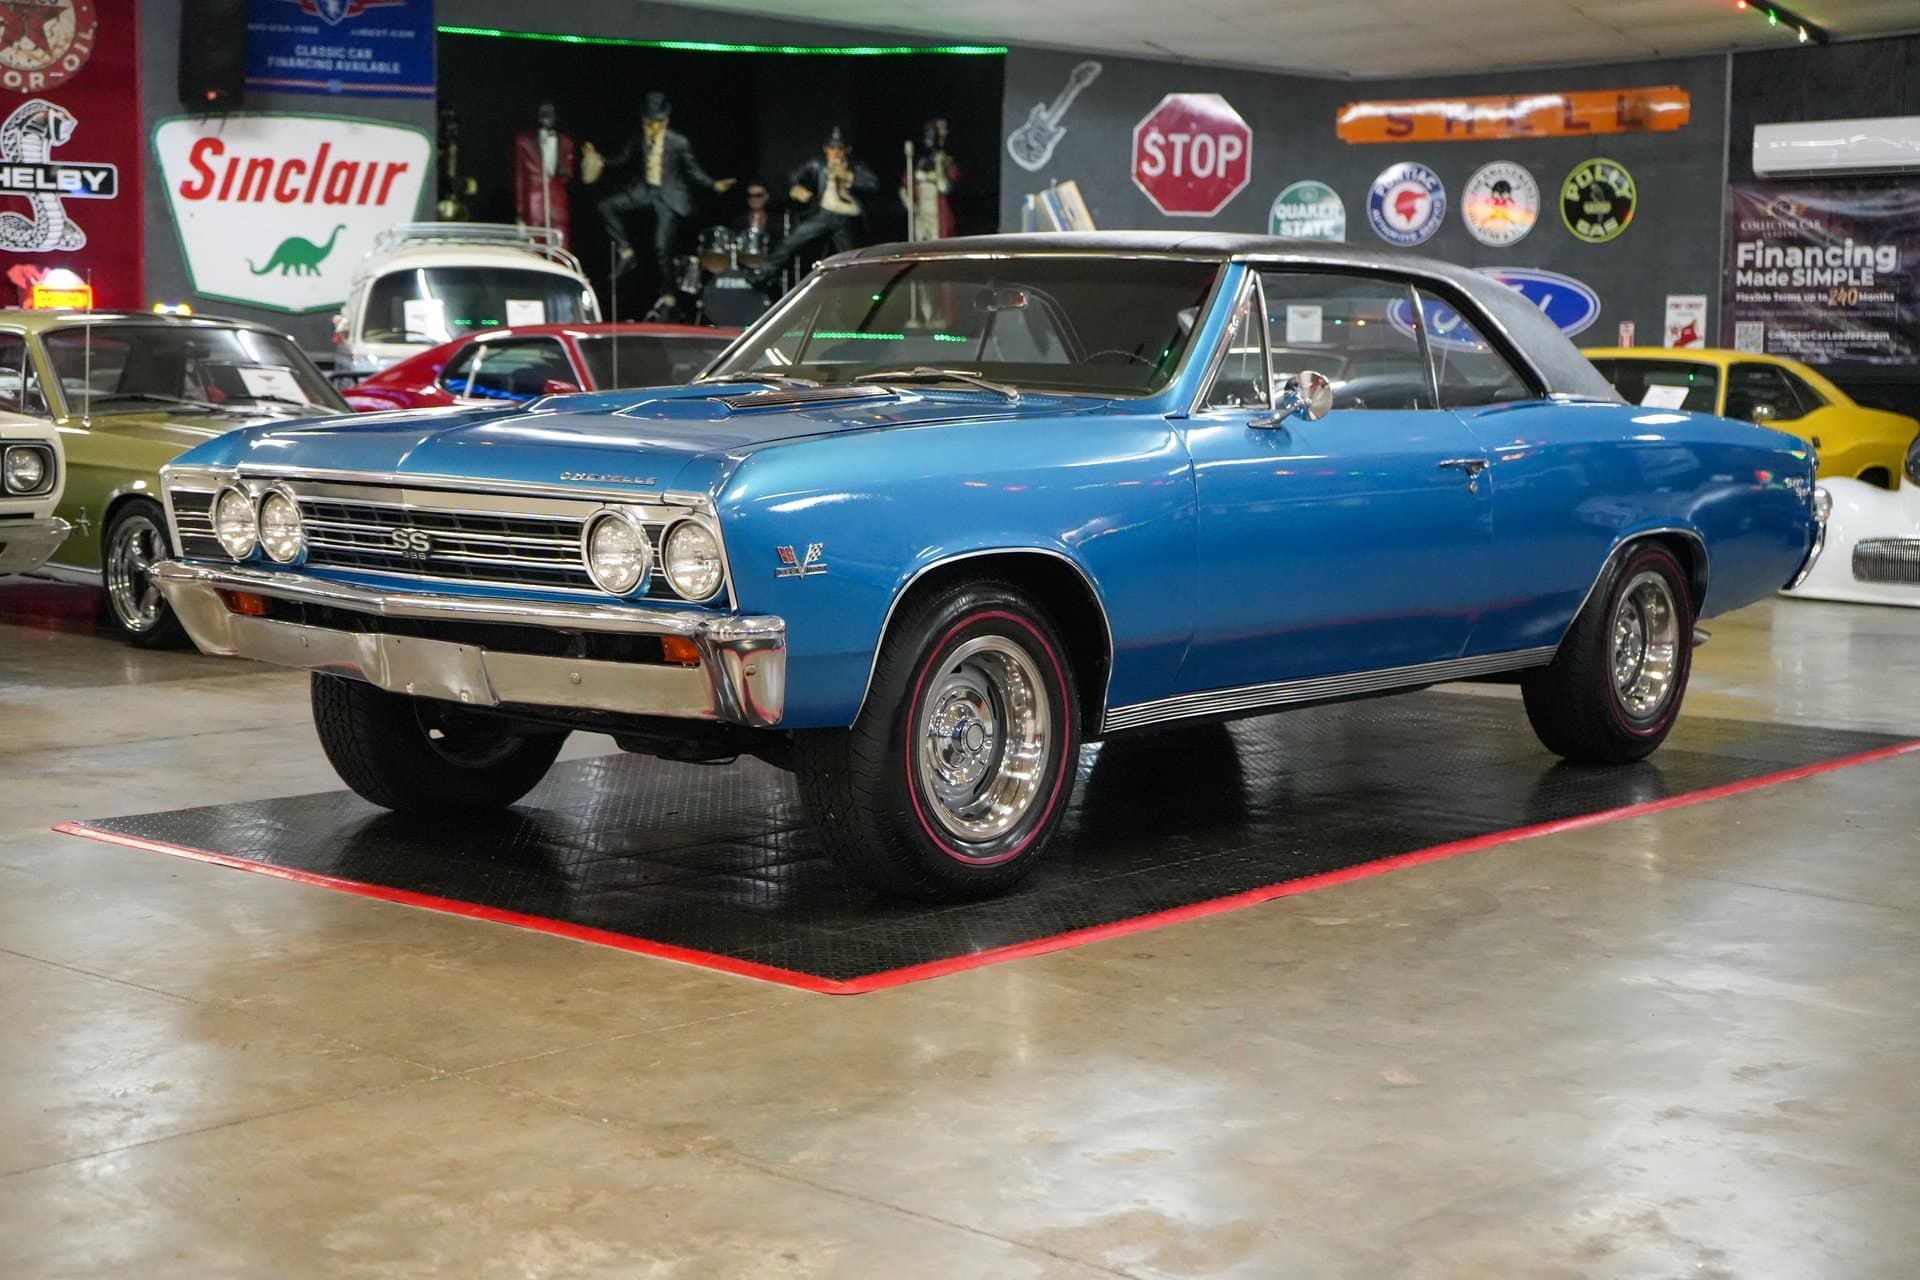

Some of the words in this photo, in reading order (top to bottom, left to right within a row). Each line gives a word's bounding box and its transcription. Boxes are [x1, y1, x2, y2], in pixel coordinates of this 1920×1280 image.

[267, 56, 333, 71] FINANCING
[334, 60, 401, 74] AVAILABLE
[294, 45, 346, 58] CLASSIC
[348, 48, 373, 60] CAR
[1385, 95, 1644, 137] SHELL
[1142, 133, 1243, 179] STOP
[0, 166, 108, 191] HELBY
[179, 136, 409, 206] Sinclair
[1566, 165, 1633, 203] POLLY
[1737, 239, 1898, 273] Financing
[1736, 268, 1790, 287] Made
[1792, 267, 1875, 287] SIMPLE
[1735, 291, 1771, 302] Flexible
[1773, 291, 1802, 302] Terms
[1804, 293, 1817, 304] up
[1818, 292, 1828, 302] to
[1828, 287, 1858, 307] 240
[1859, 291, 1895, 302] Months
[391, 529, 430, 552] SS
